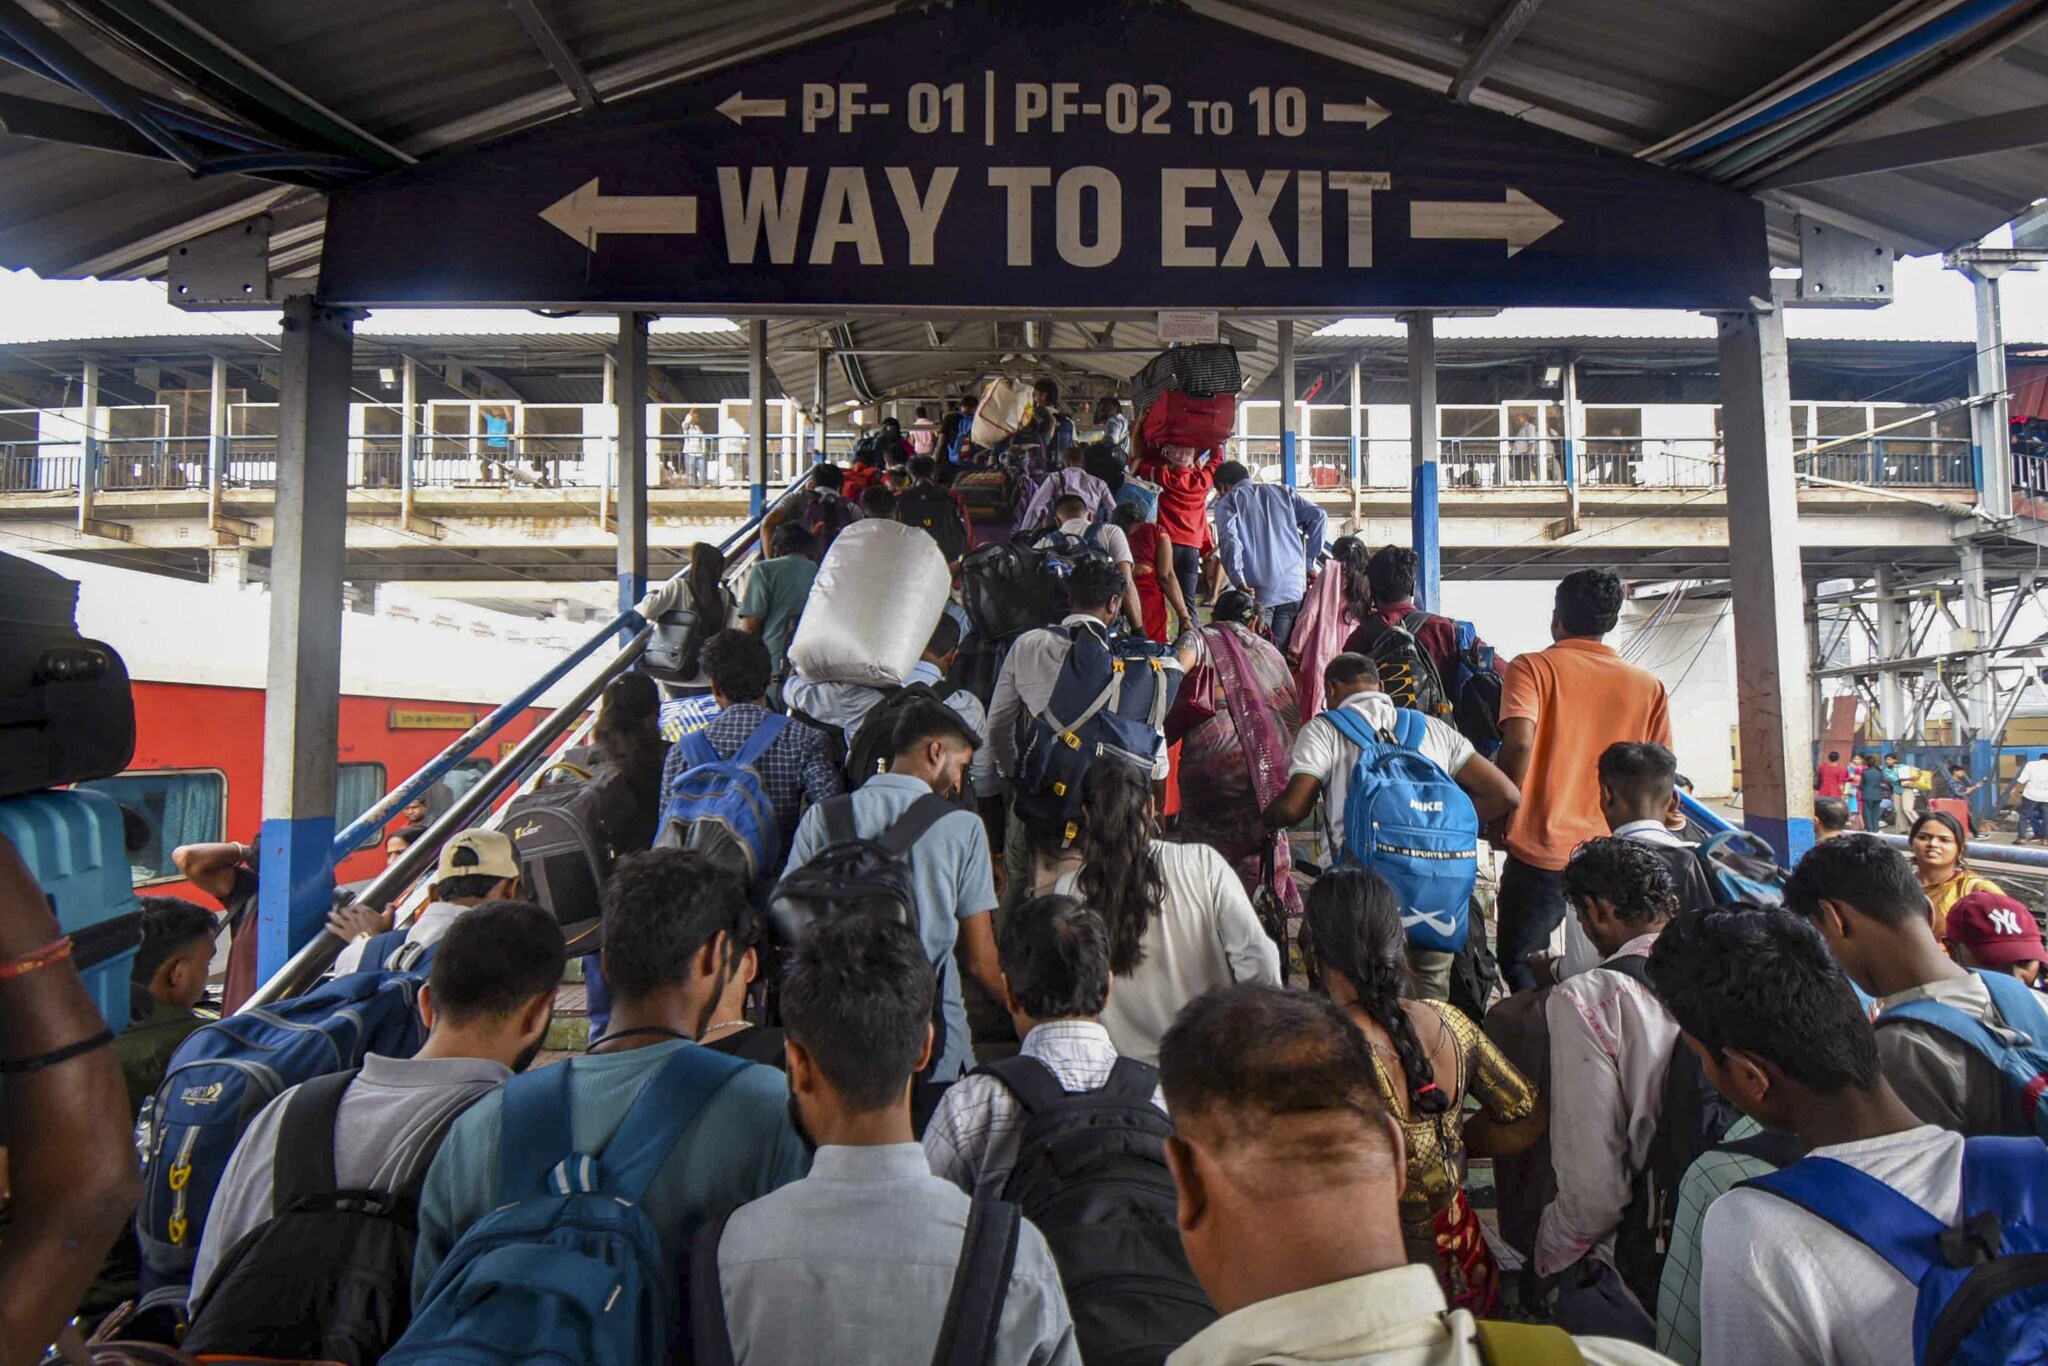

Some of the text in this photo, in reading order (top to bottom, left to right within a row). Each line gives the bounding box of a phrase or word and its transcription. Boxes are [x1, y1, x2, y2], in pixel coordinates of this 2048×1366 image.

[803, 82, 964, 133] PF- 01
[1015, 83, 1306, 136] PF-02 TO 10
[717, 166, 1391, 267] WAY TO EXIT
[1410, 799, 1443, 812] NIKE
[1411, 849, 1443, 859] SPORTS
[1988, 908, 2022, 935] NY
